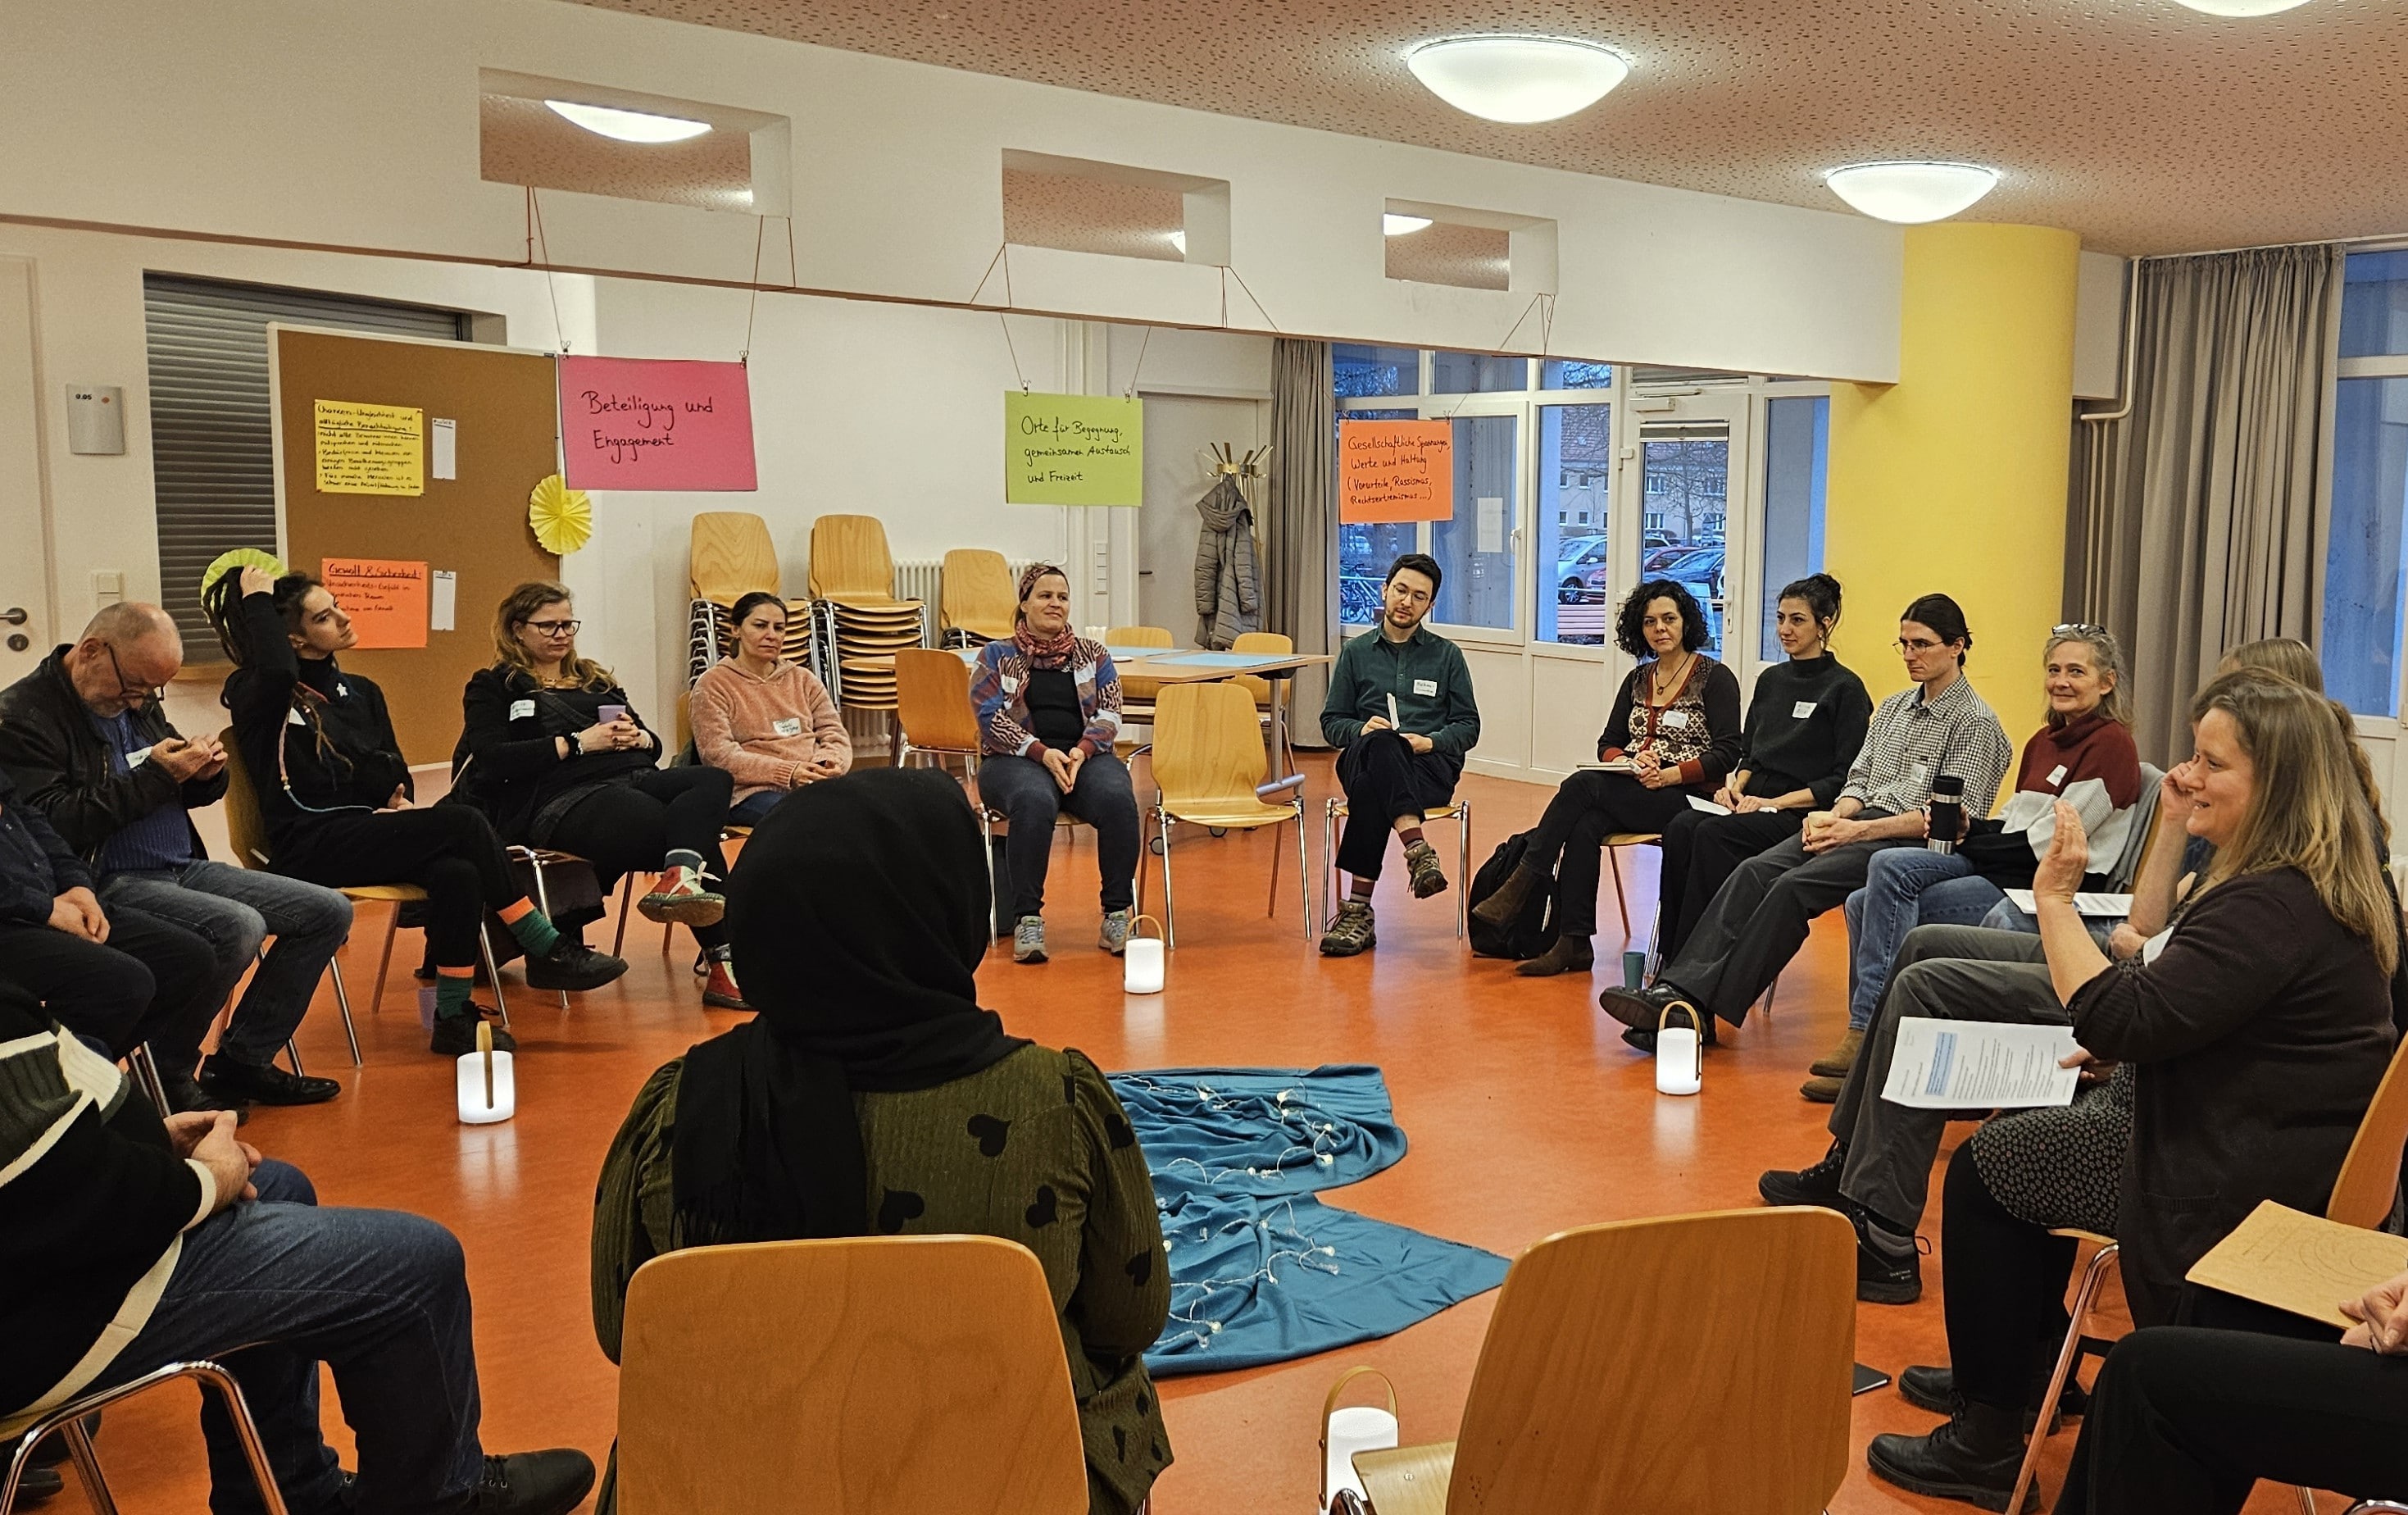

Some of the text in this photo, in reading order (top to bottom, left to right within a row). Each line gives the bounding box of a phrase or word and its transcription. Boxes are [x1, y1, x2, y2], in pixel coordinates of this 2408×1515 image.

[581, 390, 713, 431] Beteiligung und
[1021, 415, 1123, 443] Orte für Begegnung,
[593, 430, 675, 464] Engagement
[1025, 445, 1131, 467] gemeinsamen Austausch
[1347, 434, 1415, 456] Gesellschaftliche
[1351, 454, 1427, 474] Werte und Haltung
[1027, 471, 1084, 484] und Freizeit
[1392, 475, 1433, 487] Rassismus,
